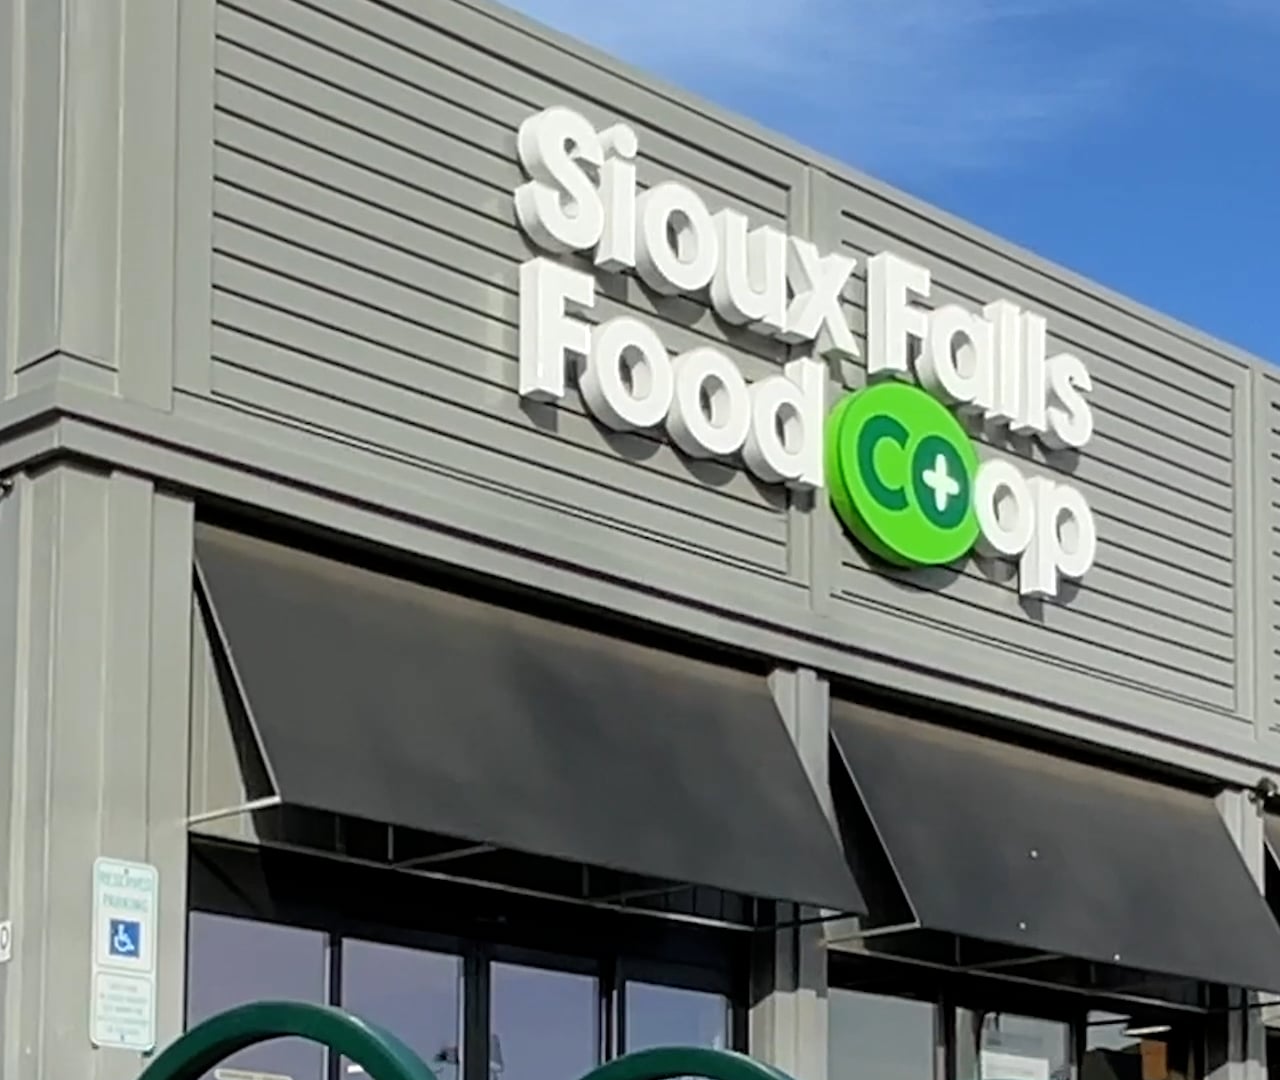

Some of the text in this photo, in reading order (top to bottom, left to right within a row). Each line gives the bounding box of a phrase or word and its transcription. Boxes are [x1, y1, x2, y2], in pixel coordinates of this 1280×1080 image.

[515, 106, 1093, 448] Sioux Falls
[519, 256, 824, 489] Food
